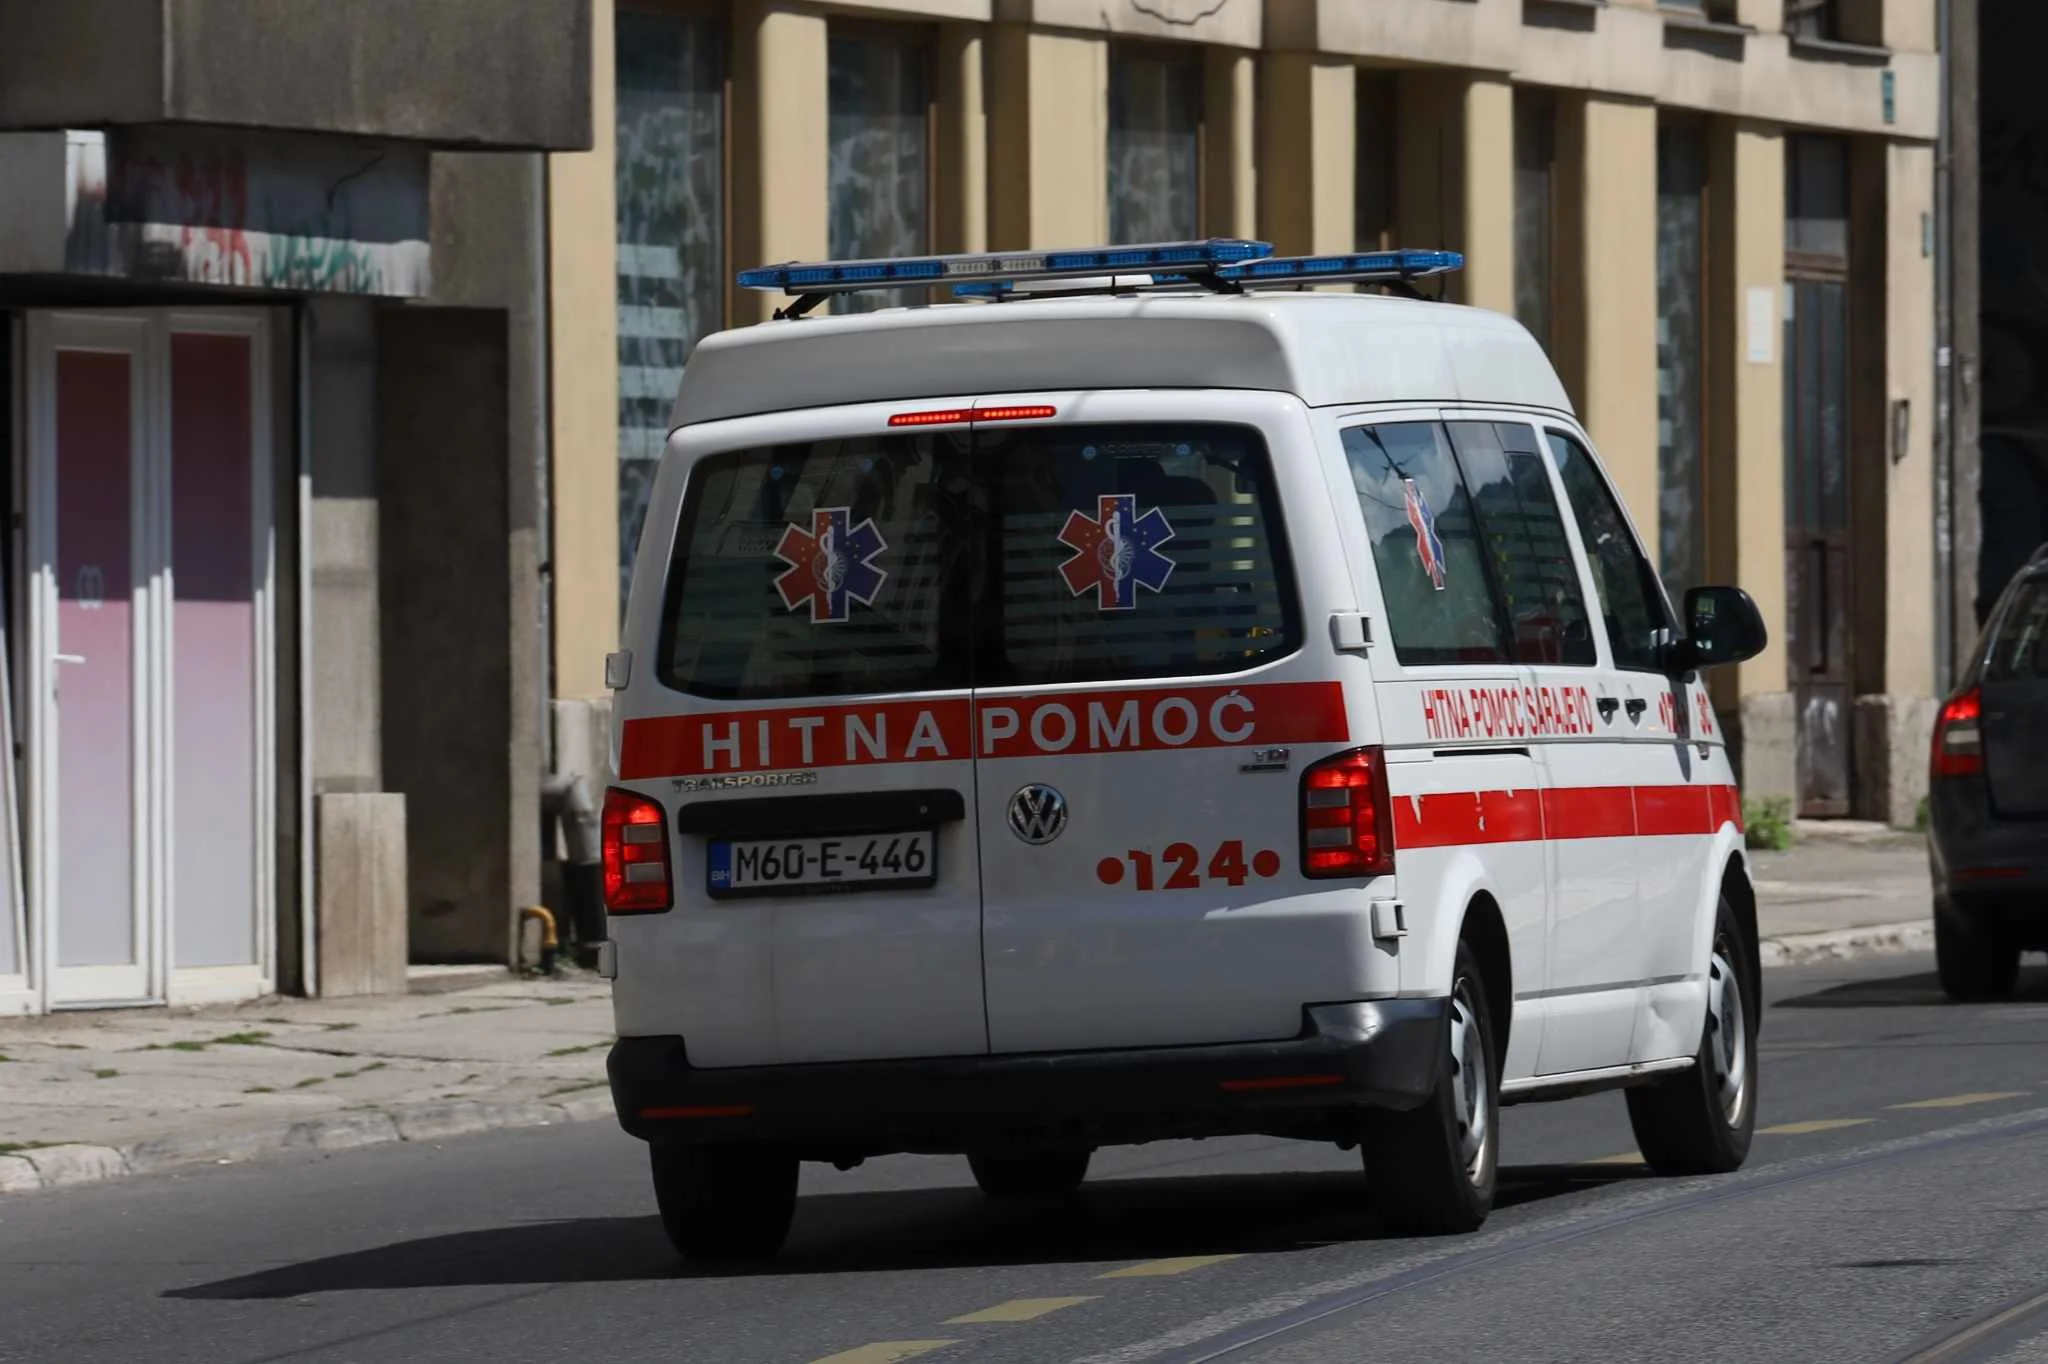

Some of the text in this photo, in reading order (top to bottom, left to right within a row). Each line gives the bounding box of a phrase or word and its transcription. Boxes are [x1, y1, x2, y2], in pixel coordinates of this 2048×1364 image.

[702, 690, 1256, 769] HITNA POMOĆ
[1421, 688, 1472, 739] HITNA
[1524, 686, 1594, 736] SARAJEVO
[671, 771, 818, 793] TRANSPORTER
[735, 837, 926, 882] M60-E-446
[1127, 840, 1249, 891] 124
